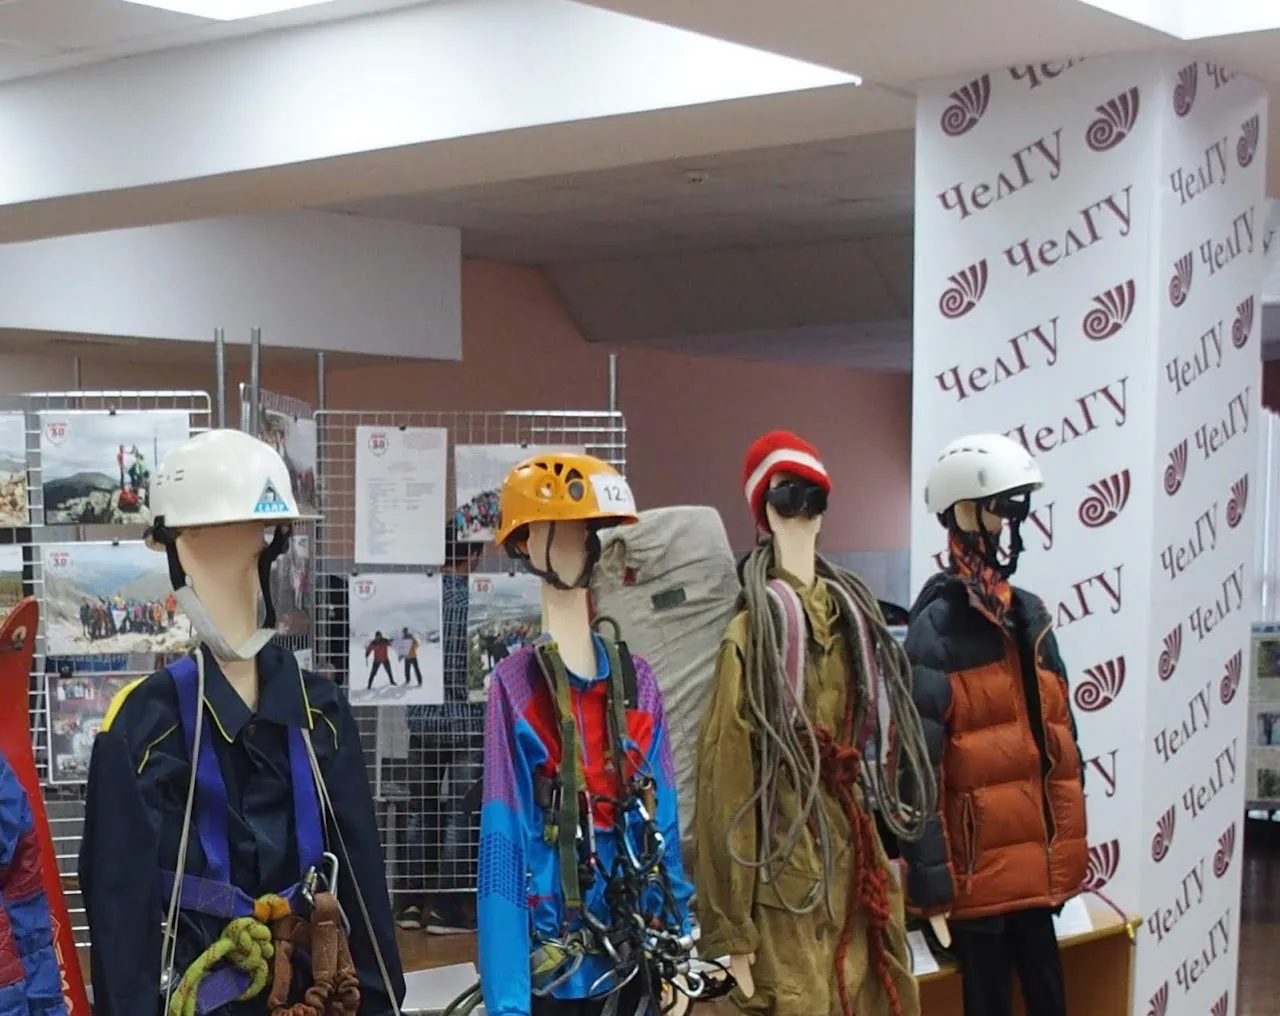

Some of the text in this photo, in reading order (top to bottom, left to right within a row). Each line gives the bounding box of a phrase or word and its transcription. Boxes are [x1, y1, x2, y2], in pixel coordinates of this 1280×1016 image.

[936, 127, 1063, 221] ЧелГУ
[1169, 136, 1228, 206] ЧелГУ
[1001, 184, 1133, 277] ЧелГУ
[1199, 206, 1255, 277] ЧелГУ
[934, 316, 1060, 403] ЧелГУ
[1165, 319, 1224, 395] ЧелГУ
[1193, 386, 1251, 461] ЧелГУ
[1159, 503, 1218, 581] ЧелГУ
[1187, 563, 1245, 642] ЧелГУ
[1153, 681, 1212, 764] ЧелГУ
[1182, 738, 1238, 819] ЧелГУ
[1146, 857, 1205, 944] ЧелГУ
[1174, 908, 1231, 994] ЧелГУ
